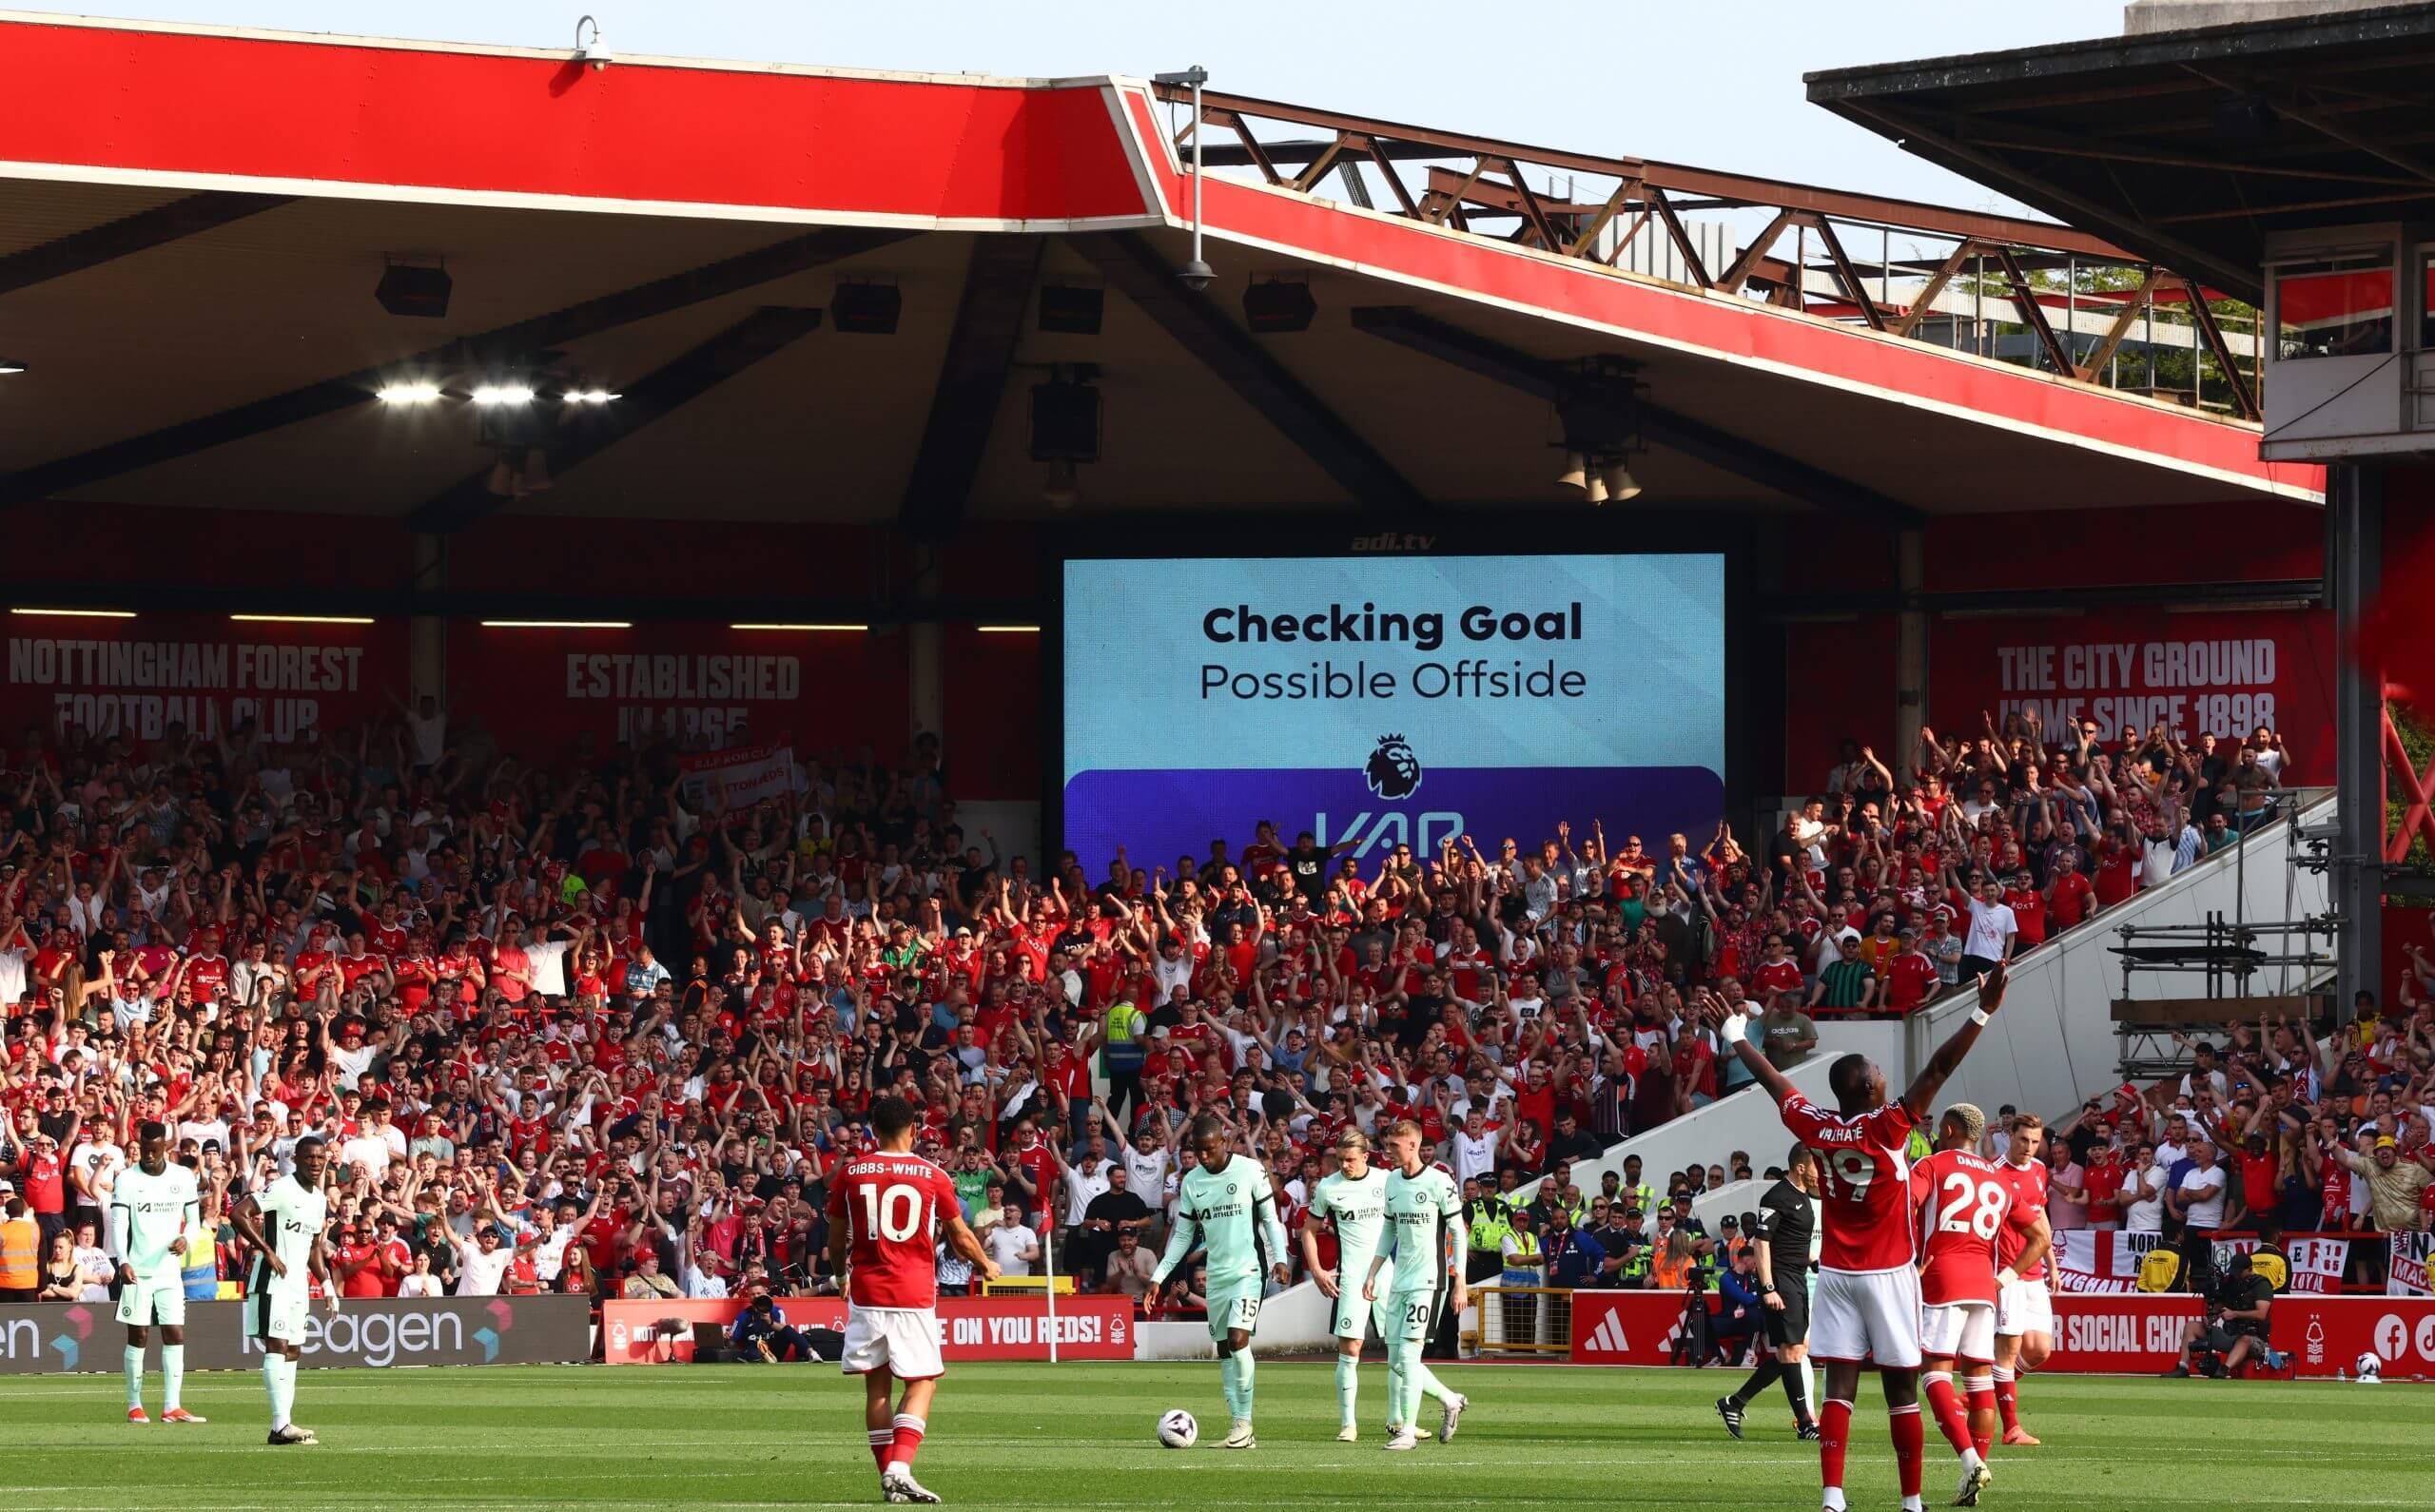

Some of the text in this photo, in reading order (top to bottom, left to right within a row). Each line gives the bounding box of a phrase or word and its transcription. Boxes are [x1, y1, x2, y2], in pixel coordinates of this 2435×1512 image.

[1351, 532, 1436, 552] adi.tv
[1203, 602, 1583, 650] Checking Goal
[9, 638, 364, 692] NOTTINGHAM FOREST
[565, 653, 800, 700] ESTABLISHED
[1200, 658, 1587, 700] Possible Offside
[1997, 638, 2275, 691] THE CITY GROUND
[2093, 694, 2187, 743] SINCE
[2194, 691, 2275, 740] 1898
[1315, 811, 1469, 859] VAR
[847, 1162, 932, 1179] GIBBS-WHITE
[1809, 1147, 1875, 1203] 19
[1956, 1154, 1995, 1174] DANILO
[859, 1183, 923, 1243] 10
[1212, 1203, 1242, 1212] INFINITE
[1938, 1172, 2006, 1240] 28
[2290, 1271, 2325, 1292] LOYAL
[1241, 1298, 1257, 1316] 15
[1406, 1304, 1430, 1324] 20
[953, 1317, 984, 1345] ON
[987, 1316, 1032, 1345] YOU
[1037, 1315, 1101, 1345] REDS!
[2068, 1314, 2141, 1352] SOCIAL
